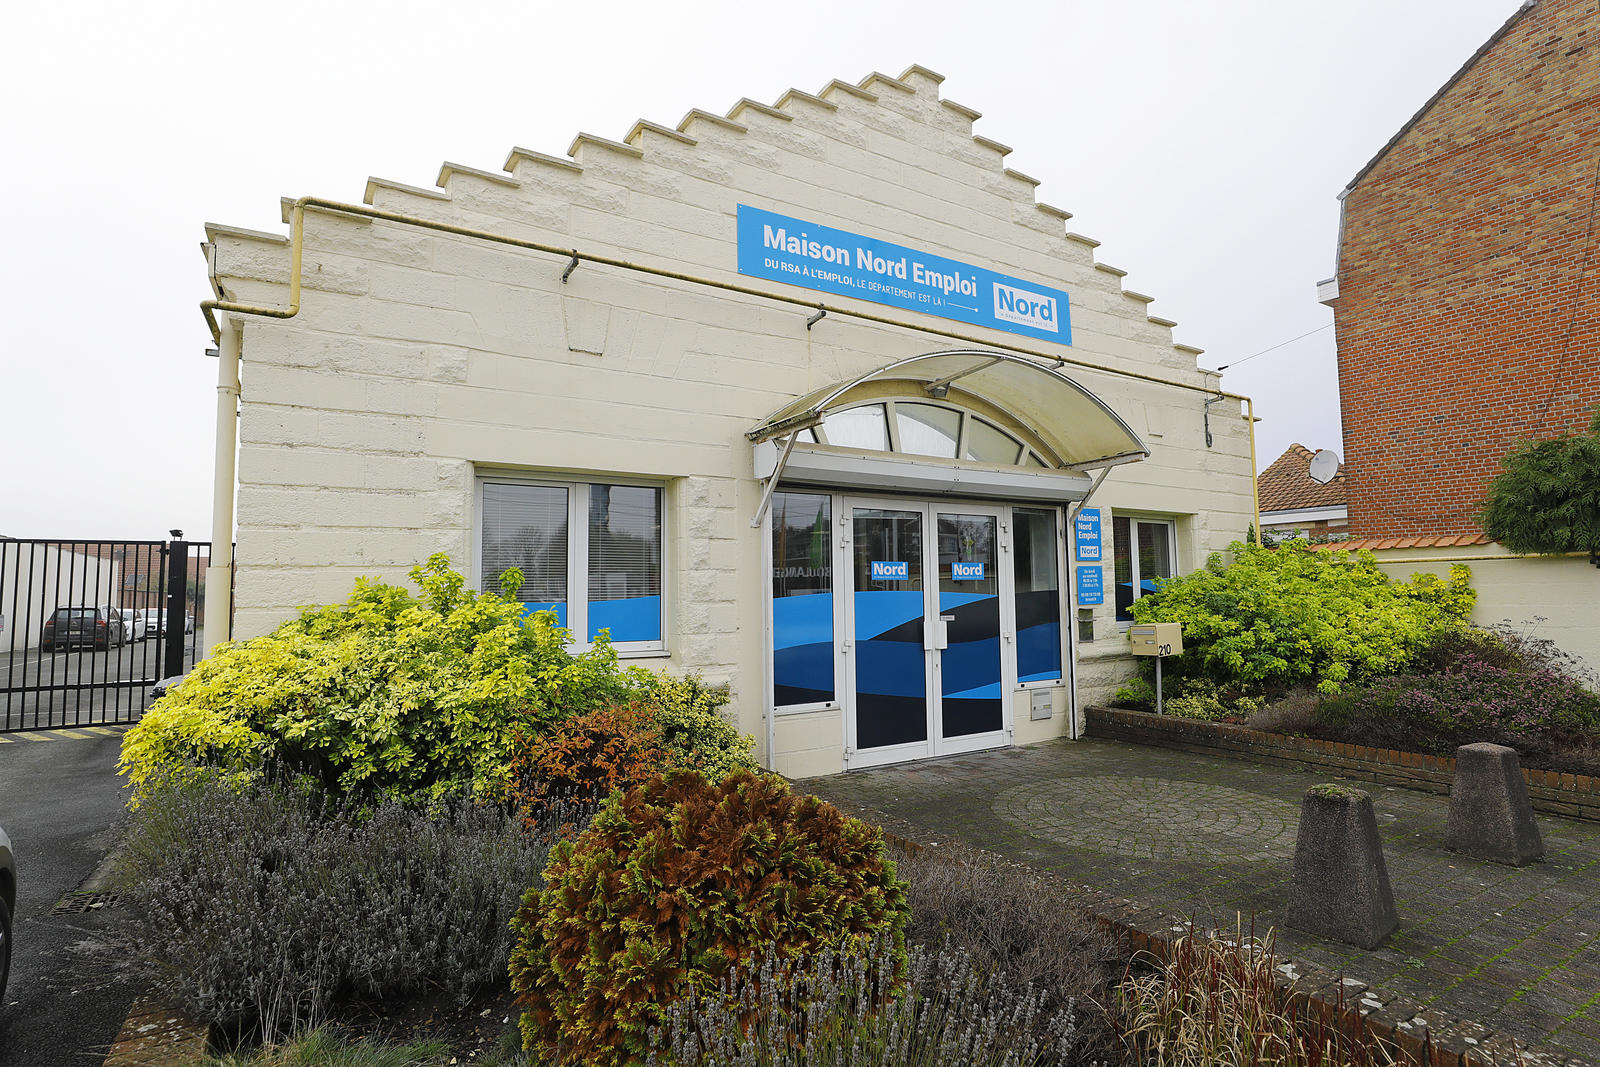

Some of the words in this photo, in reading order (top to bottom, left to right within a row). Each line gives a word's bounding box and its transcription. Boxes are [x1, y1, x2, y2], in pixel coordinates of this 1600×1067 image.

[763, 224, 850, 266] Maison
[857, 247, 907, 280] Nord
[913, 262, 977, 297] Emploi
[764, 257, 779, 270] DU
[780, 261, 801, 275] RSA
[802, 264, 810, 277] À
[811, 268, 855, 288] L'EMPLOI,
[856, 279, 866, 289] LE
[868, 279, 917, 300] DÉPARTEMENT
[918, 293, 931, 303] EST
[998, 287, 1053, 322] Nord
[1078, 513, 1099, 522] Maison
[1078, 522, 1092, 531] Nord
[1078, 531, 1098, 541] Emploi
[1081, 547, 1098, 555] Nord
[873, 562, 906, 576] Nord
[953, 563, 983, 576] Nord
[1158, 643, 1172, 656] 210
